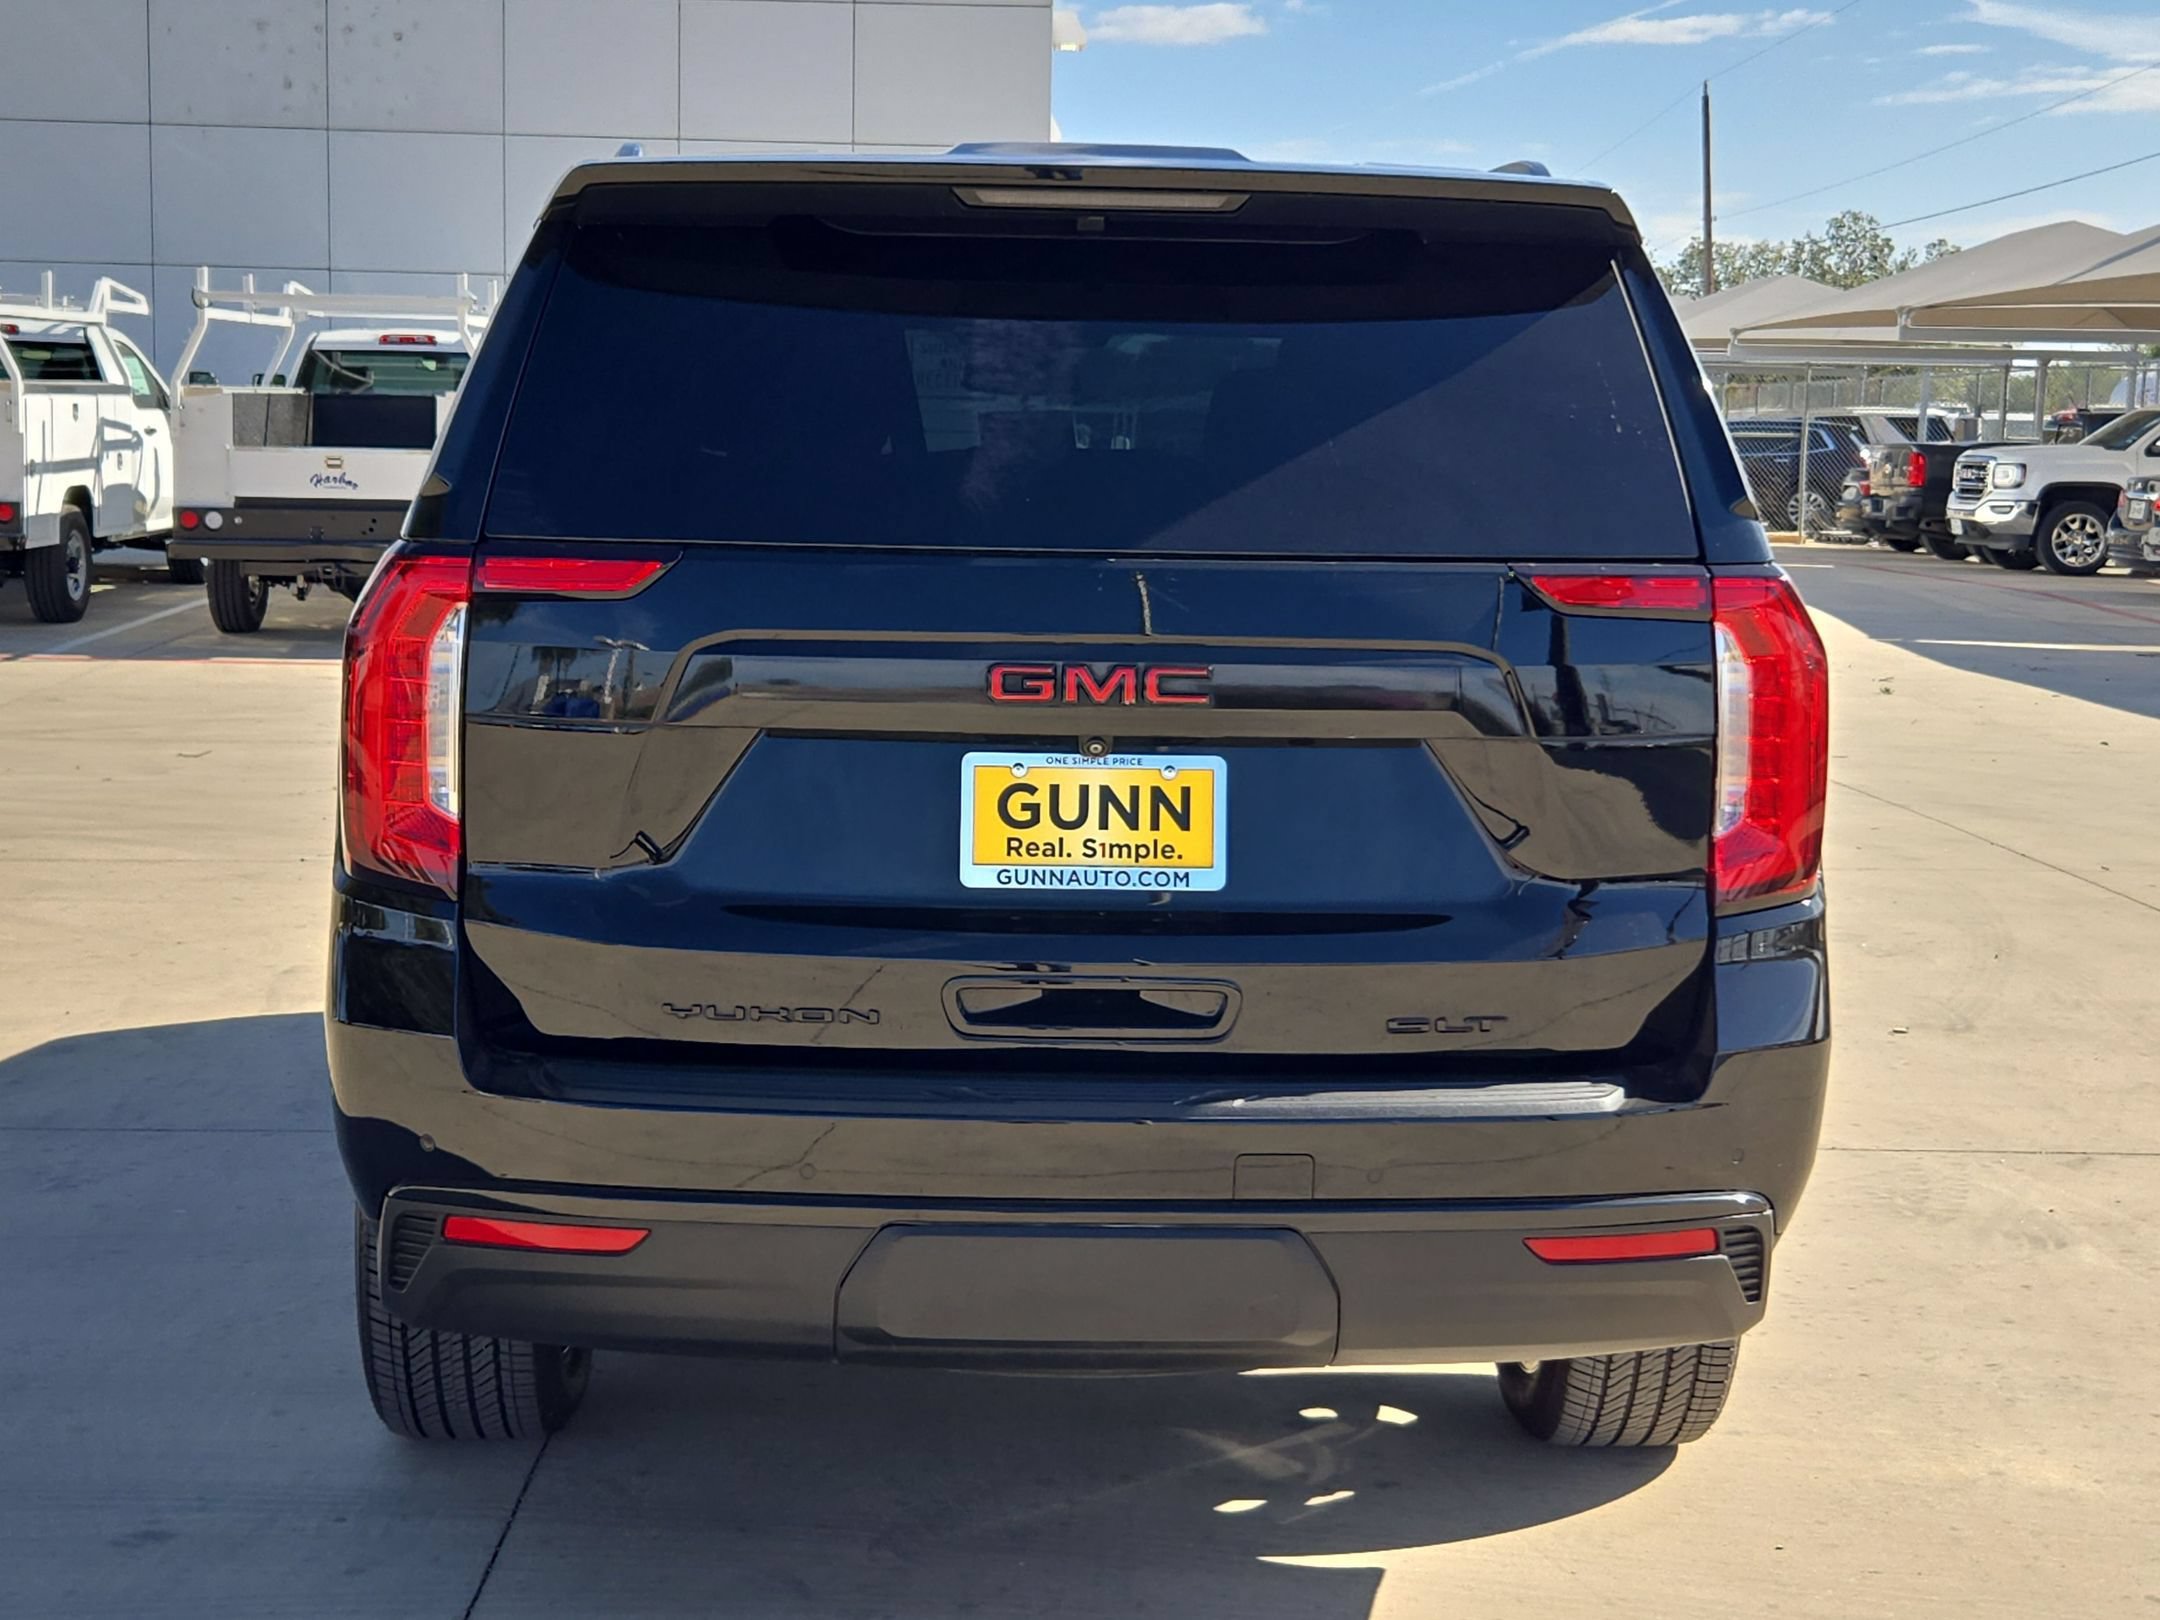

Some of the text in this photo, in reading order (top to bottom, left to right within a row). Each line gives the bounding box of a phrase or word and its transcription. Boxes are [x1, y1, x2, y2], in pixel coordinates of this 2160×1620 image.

[988, 663, 1213, 705] GMC
[1045, 756, 1143, 767] ONE SIMPLE PRICE
[997, 782, 1191, 832] GUNN
[1006, 837, 1072, 858] Real.
[996, 869, 1190, 888] GUNNAUTO.COM
[662, 1002, 880, 1025] YUKON
[1386, 1015, 1508, 1034] SLT
